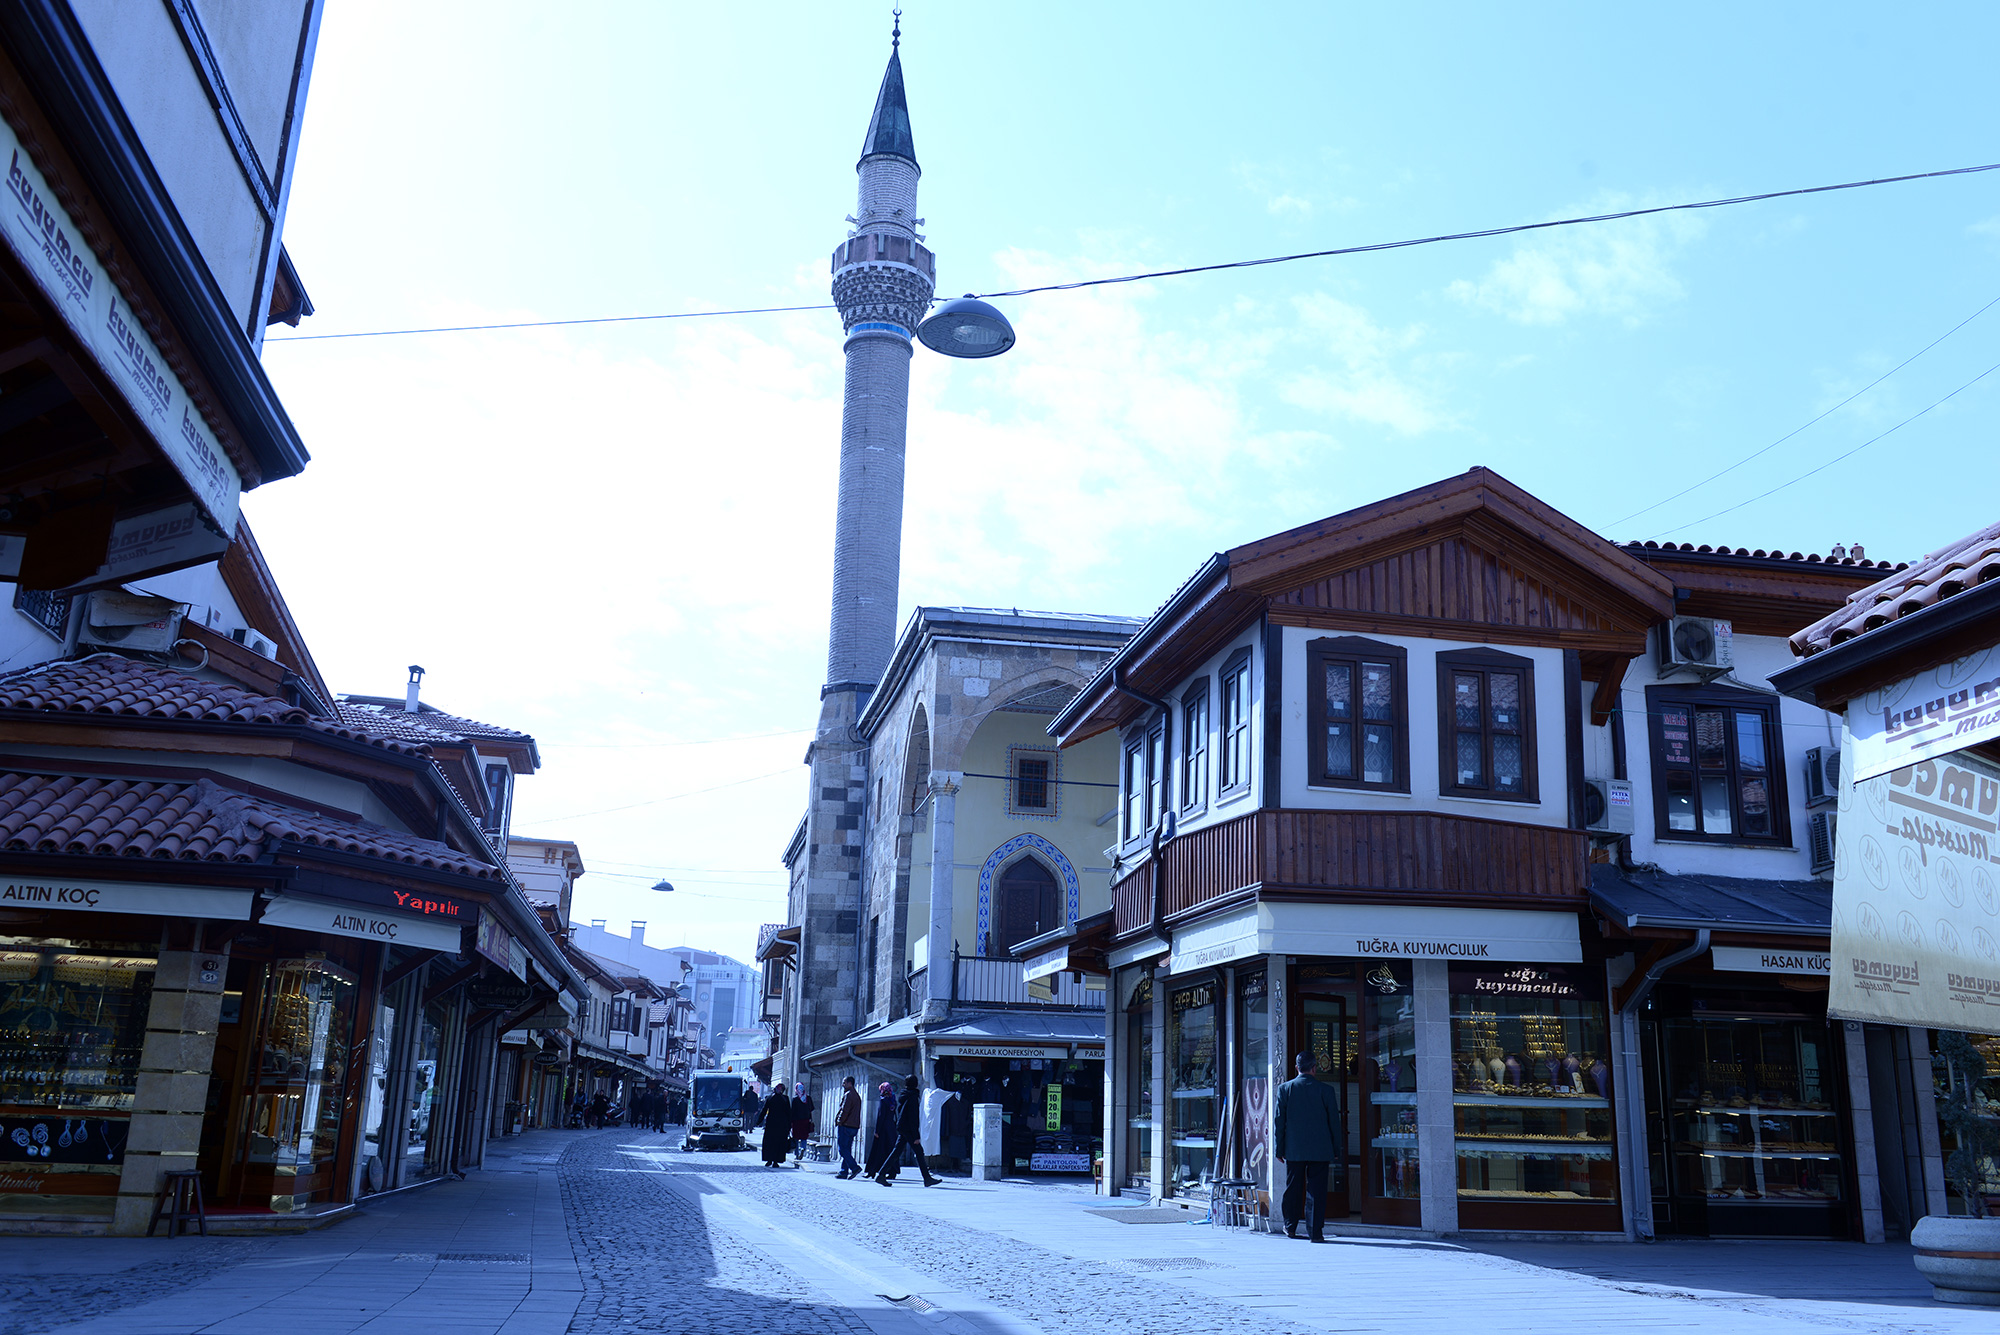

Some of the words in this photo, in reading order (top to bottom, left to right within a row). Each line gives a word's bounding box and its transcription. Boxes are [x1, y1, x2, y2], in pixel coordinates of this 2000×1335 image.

[10, 148, 93, 292] kuyumcu
[42, 241, 81, 302] mustafa
[109, 296, 171, 405] kuyumcu
[1663, 711, 1688, 726] MELİS
[3, 885, 52, 901] ALTIN
[57, 888, 100, 907] KOÇ
[393, 890, 459, 915] Yapılır
[332, 915, 366, 932] ALTIN
[370, 920, 398, 939] KOÇ
[1356, 936, 1399, 955] TUĞRA
[1403, 941, 1489, 957] KUYUMCULUK
[207, 962, 217, 970] 51
[1761, 955, 1803, 969] HASAN
[958, 1047, 996, 1055] PARLAKLAR
[998, 1047, 1045, 1057] KONFEKSİYON
